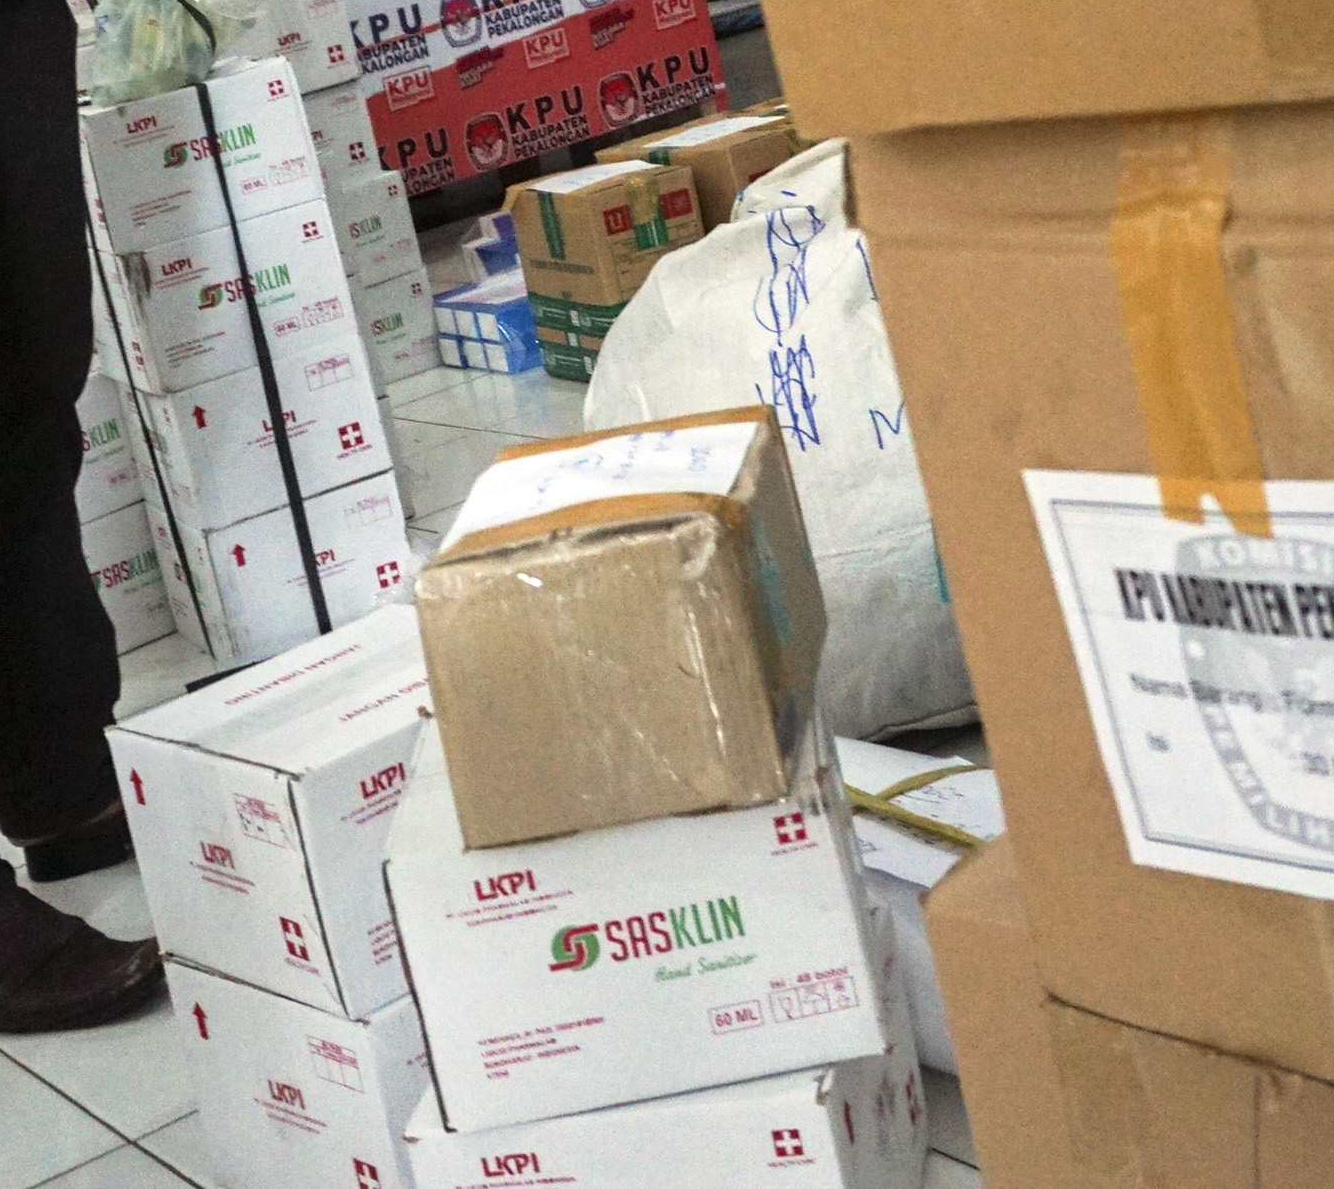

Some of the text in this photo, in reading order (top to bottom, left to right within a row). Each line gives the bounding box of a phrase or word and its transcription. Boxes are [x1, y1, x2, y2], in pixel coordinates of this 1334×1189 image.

[486, 6, 565, 38] PEKALONGAN
[526, 31, 566, 55] KPU
[386, 70, 430, 97] KPU
[636, 46, 711, 93] KPU
[641, 74, 714, 104] KABUPATEN
[644, 86, 717, 116] PEKALONGAN
[125, 115, 159, 134] LKPI
[505, 84, 584, 135] KPU
[510, 114, 589, 146] KABUPATEN
[513, 126, 591, 160] PEKALONGAN
[160, 257, 194, 277] LKPI
[101, 546, 160, 590] SASKLIN
[1113, 567, 1168, 623] KPU
[1160, 571, 1299, 637] KABUPATEN
[359, 761, 407, 801] LKPI
[472, 868, 537, 902] LKPI
[604, 894, 747, 963] SASKLIN
[480, 1151, 541, 1179] LKPI
